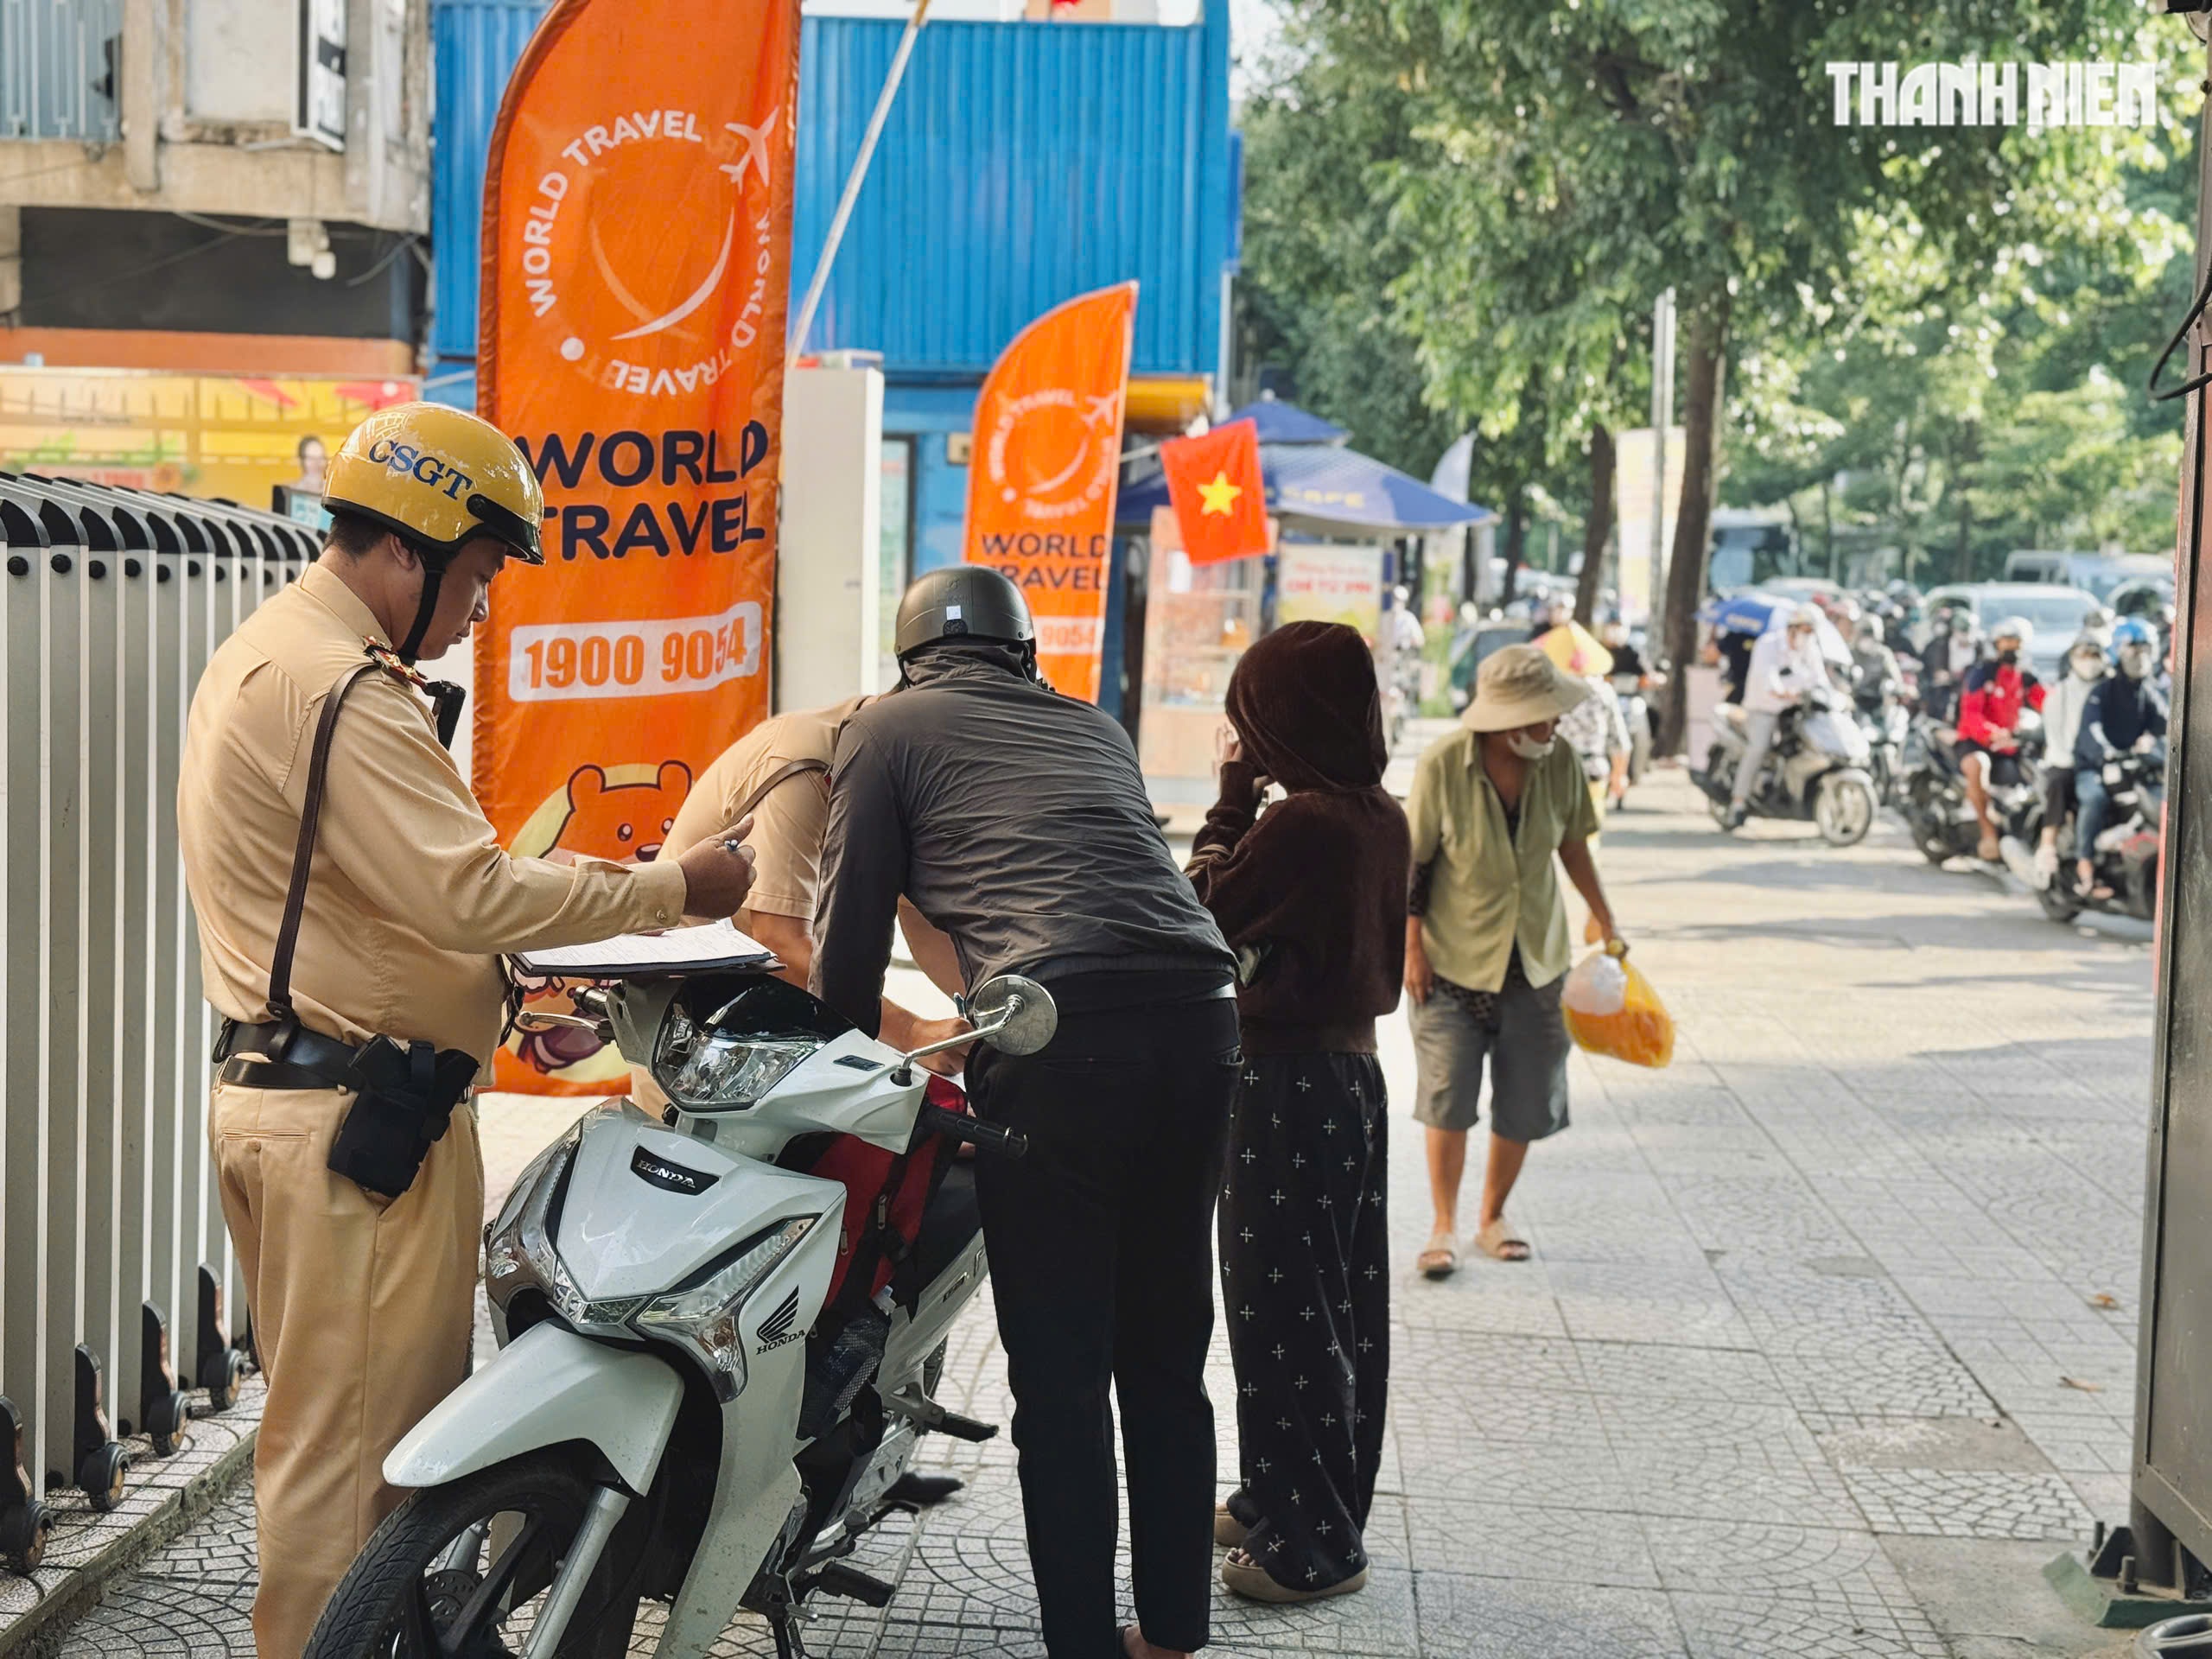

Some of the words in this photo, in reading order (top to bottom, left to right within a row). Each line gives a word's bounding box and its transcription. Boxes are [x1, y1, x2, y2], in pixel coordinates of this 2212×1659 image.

[523, 171, 569, 317] WORLD
[562, 110, 702, 167] TRAVEL
[369, 440, 474, 500] CSGT
[513, 420, 769, 490] WORLD
[543, 490, 766, 561] RAVEL
[982, 532, 1106, 558] WORLD
[991, 563, 1101, 590] RAVEL
[524, 634, 645, 690] 1900
[661, 615, 747, 683] 9054
[637, 1160, 696, 1189] HONDA
[755, 1329, 806, 1356] HONDA
